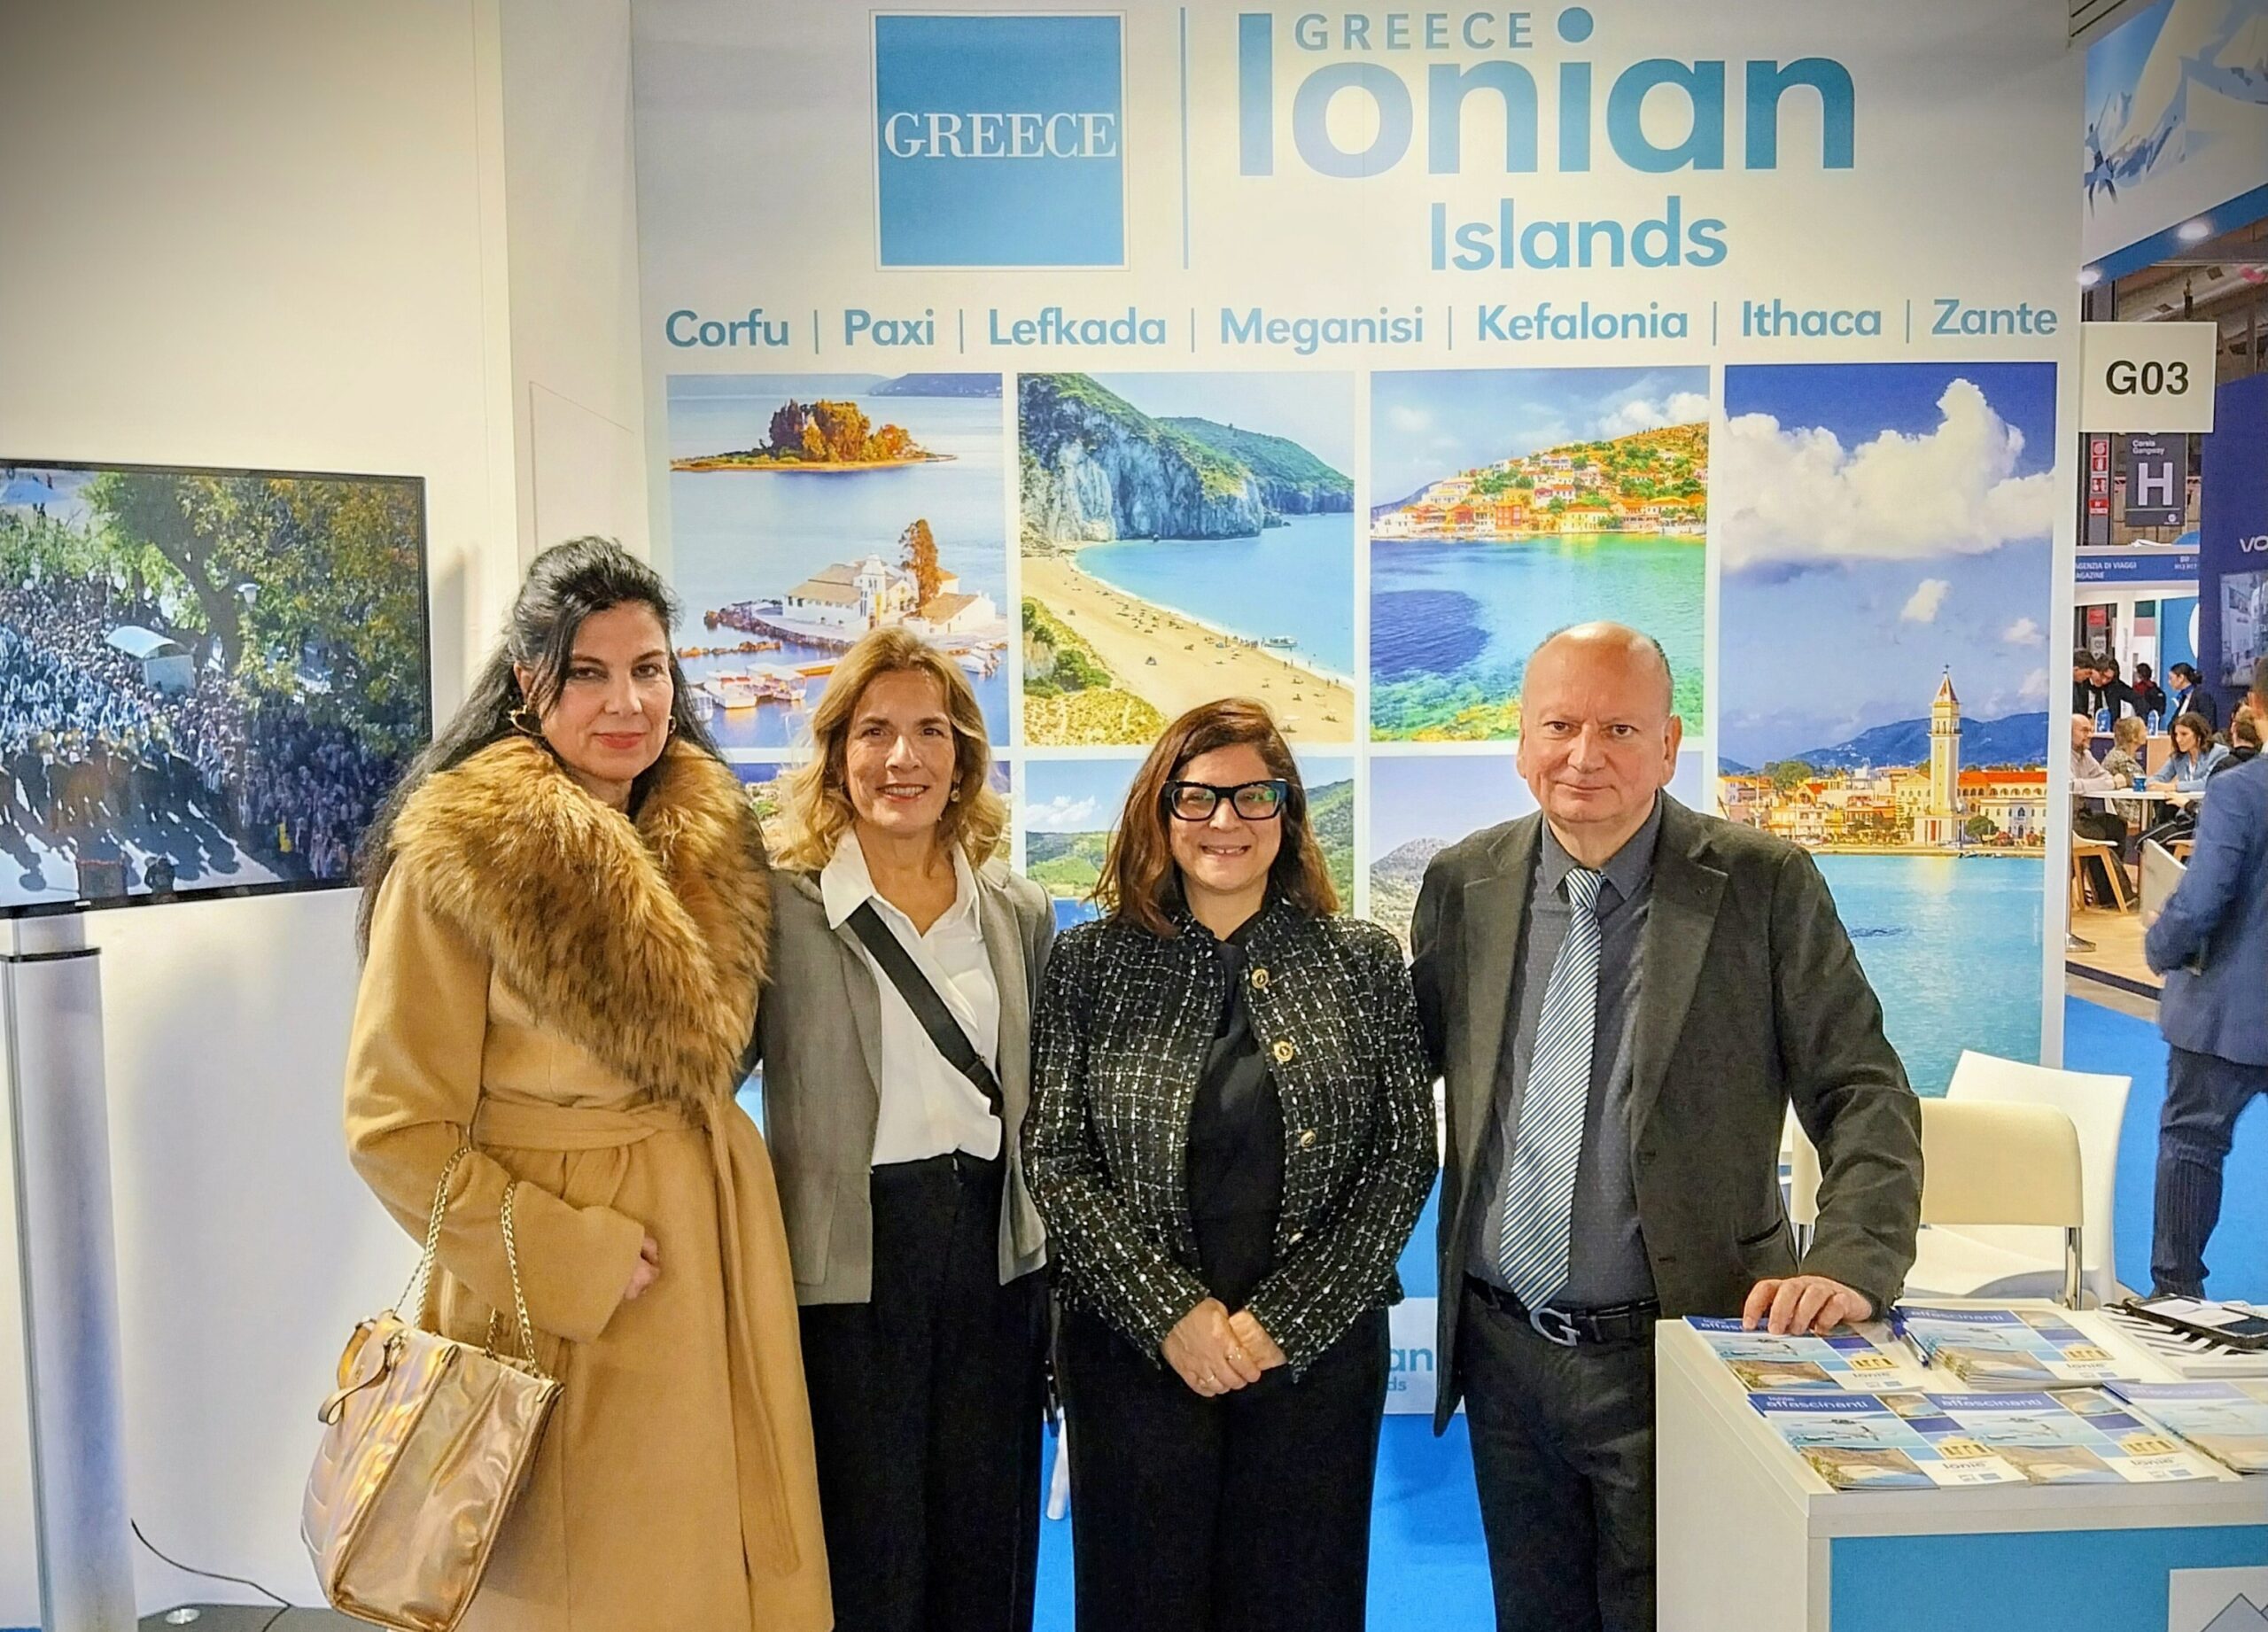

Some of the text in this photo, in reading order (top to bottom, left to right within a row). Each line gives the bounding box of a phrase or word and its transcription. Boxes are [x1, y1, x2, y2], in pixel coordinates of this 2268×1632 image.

[1294, 12, 1533, 51] GREECE
[1239, 7, 1855, 177] Ionian
[884, 112, 1116, 159] GREECE
[1431, 196, 1727, 270] Islands
[665, 299, 2057, 354] Corfu Paxi Lefkada Meganisi Kefalonia Ithaca Zante
[2106, 360, 2189, 395] G03
[2138, 462, 2173, 506] H
